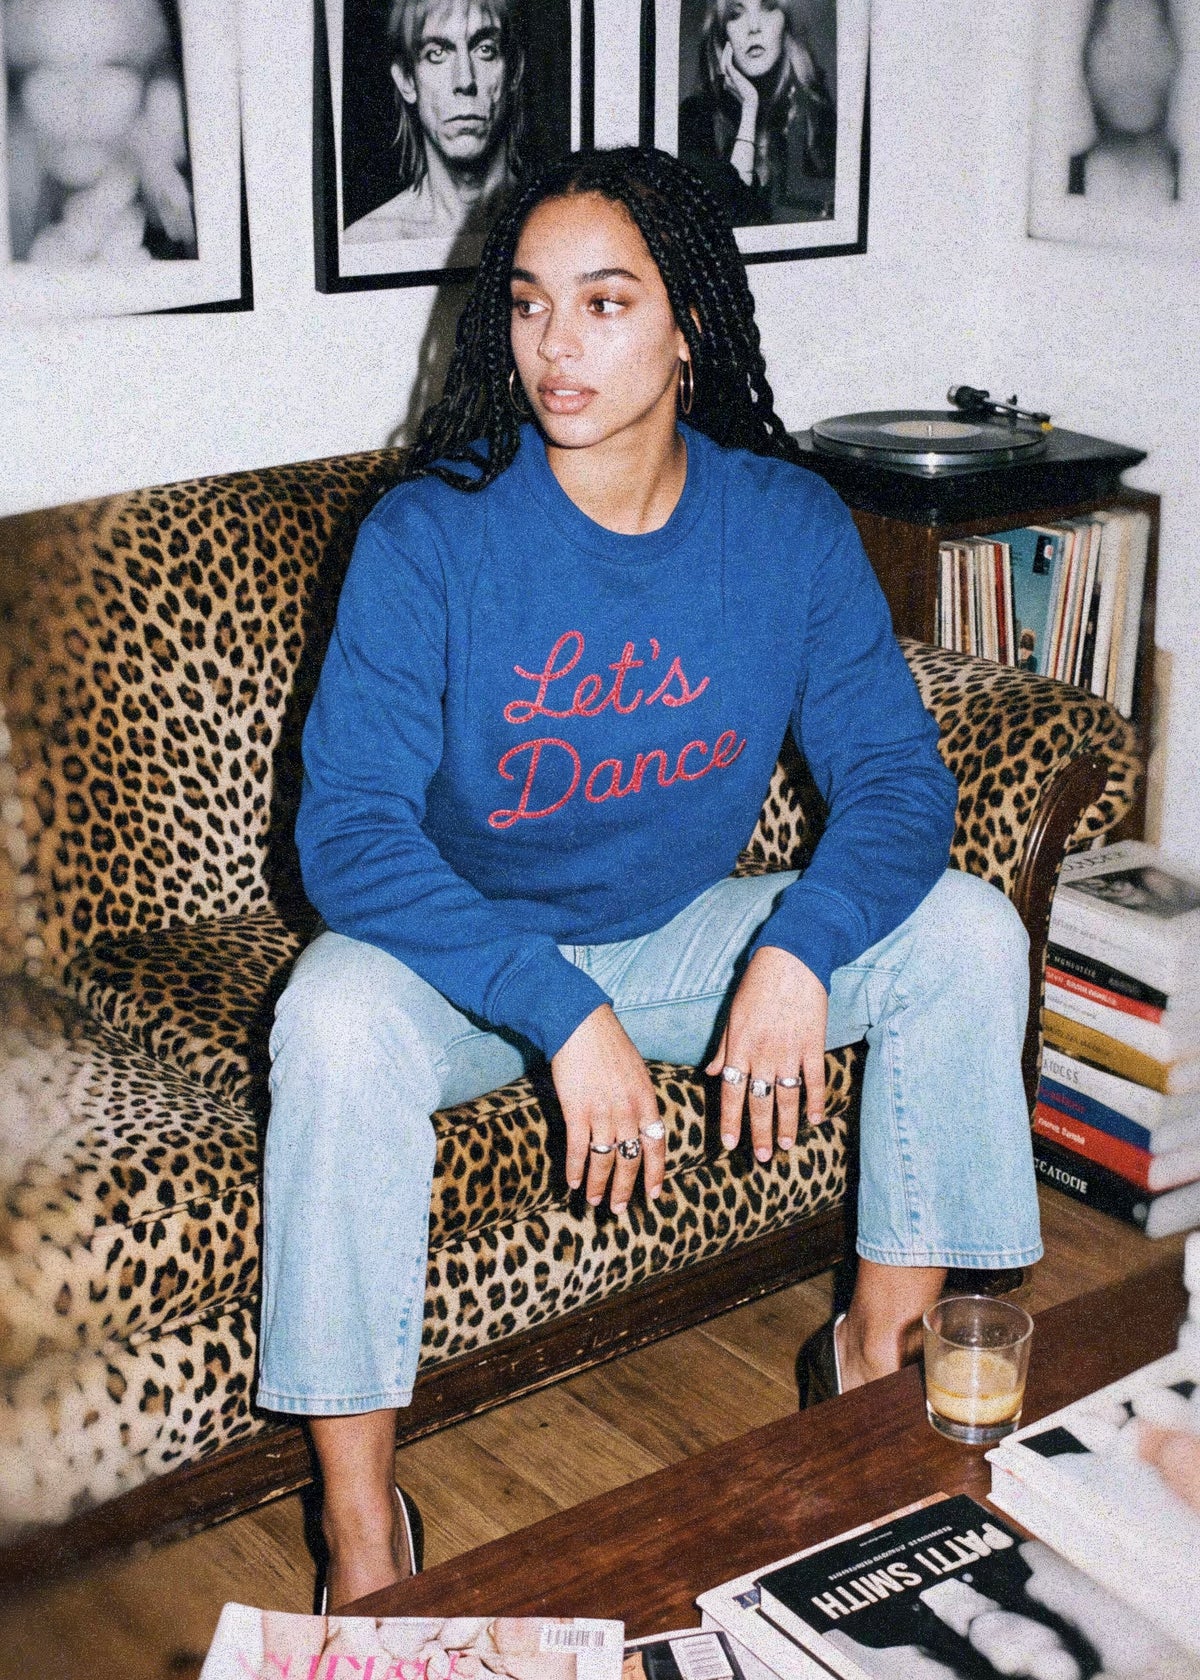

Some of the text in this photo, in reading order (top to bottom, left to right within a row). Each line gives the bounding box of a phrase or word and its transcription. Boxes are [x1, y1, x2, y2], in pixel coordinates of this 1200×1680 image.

[503, 630, 711, 724] Let's
[488, 729, 747, 829] Dance
[914, 1522, 1014, 1576] PATTI
[811, 1562, 923, 1620] SMITH
